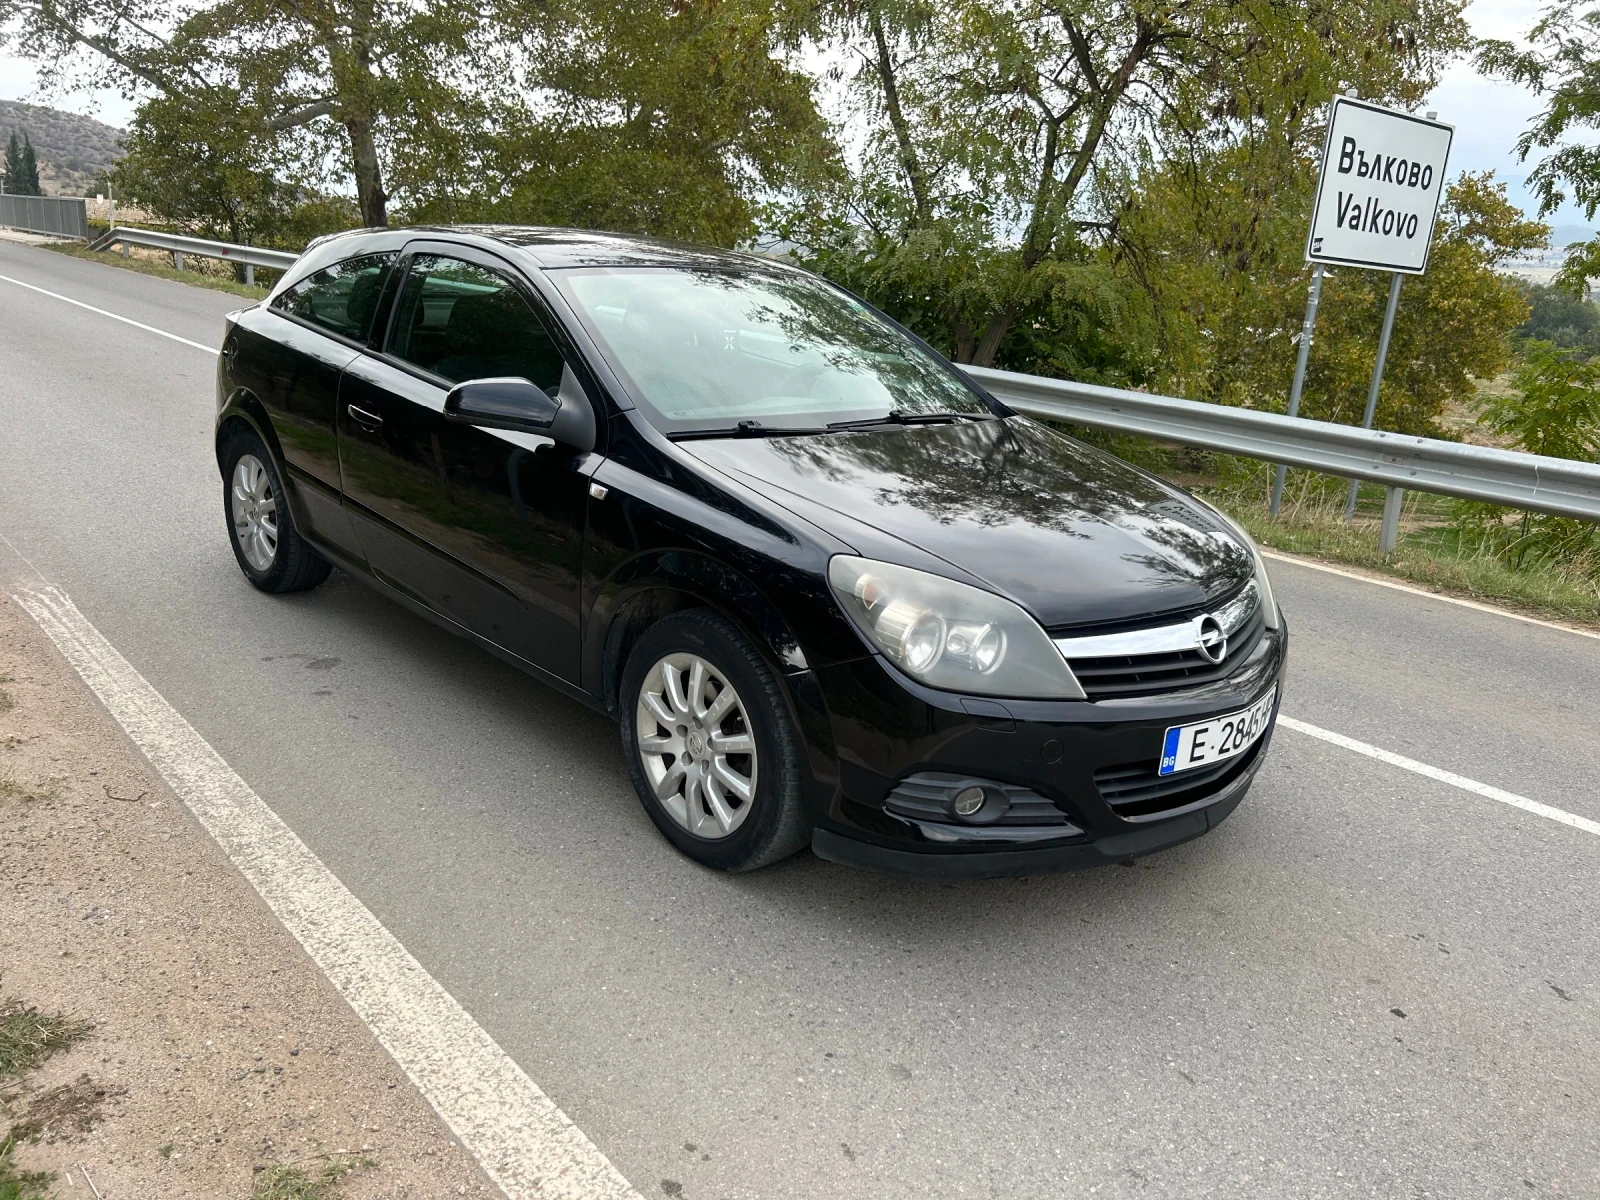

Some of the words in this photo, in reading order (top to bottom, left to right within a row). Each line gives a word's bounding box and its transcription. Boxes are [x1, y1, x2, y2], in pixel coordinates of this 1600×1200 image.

[1338, 135, 1433, 191] Вълково
[1336, 191, 1418, 240] Valkovo
[1162, 756, 1175, 768] BG
